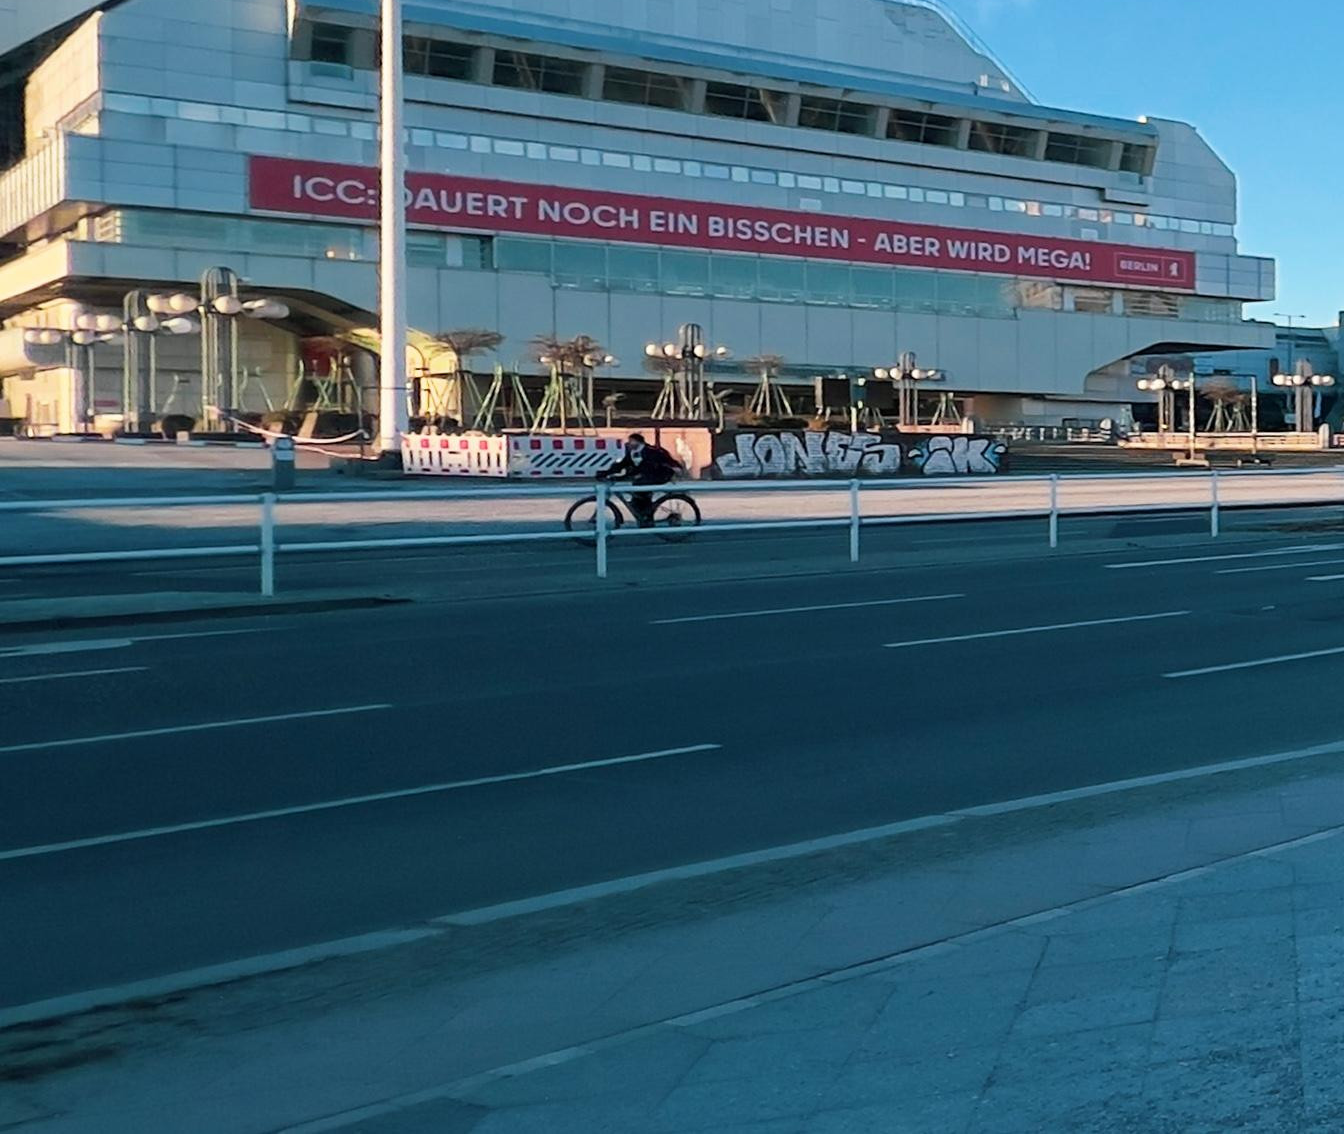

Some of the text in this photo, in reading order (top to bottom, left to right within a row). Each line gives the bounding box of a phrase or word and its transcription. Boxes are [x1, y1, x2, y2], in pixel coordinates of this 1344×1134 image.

[293, 175, 376, 205] ICC:
[538, 198, 639, 229] NOCH
[650, 211, 698, 235] EIN
[708, 216, 849, 249] BISSCHEN
[873, 232, 941, 257] ABER
[947, 239, 1011, 263] WIRD
[1017, 246, 1091, 271] MEGA!
[1119, 259, 1159, 272] BERLIN
